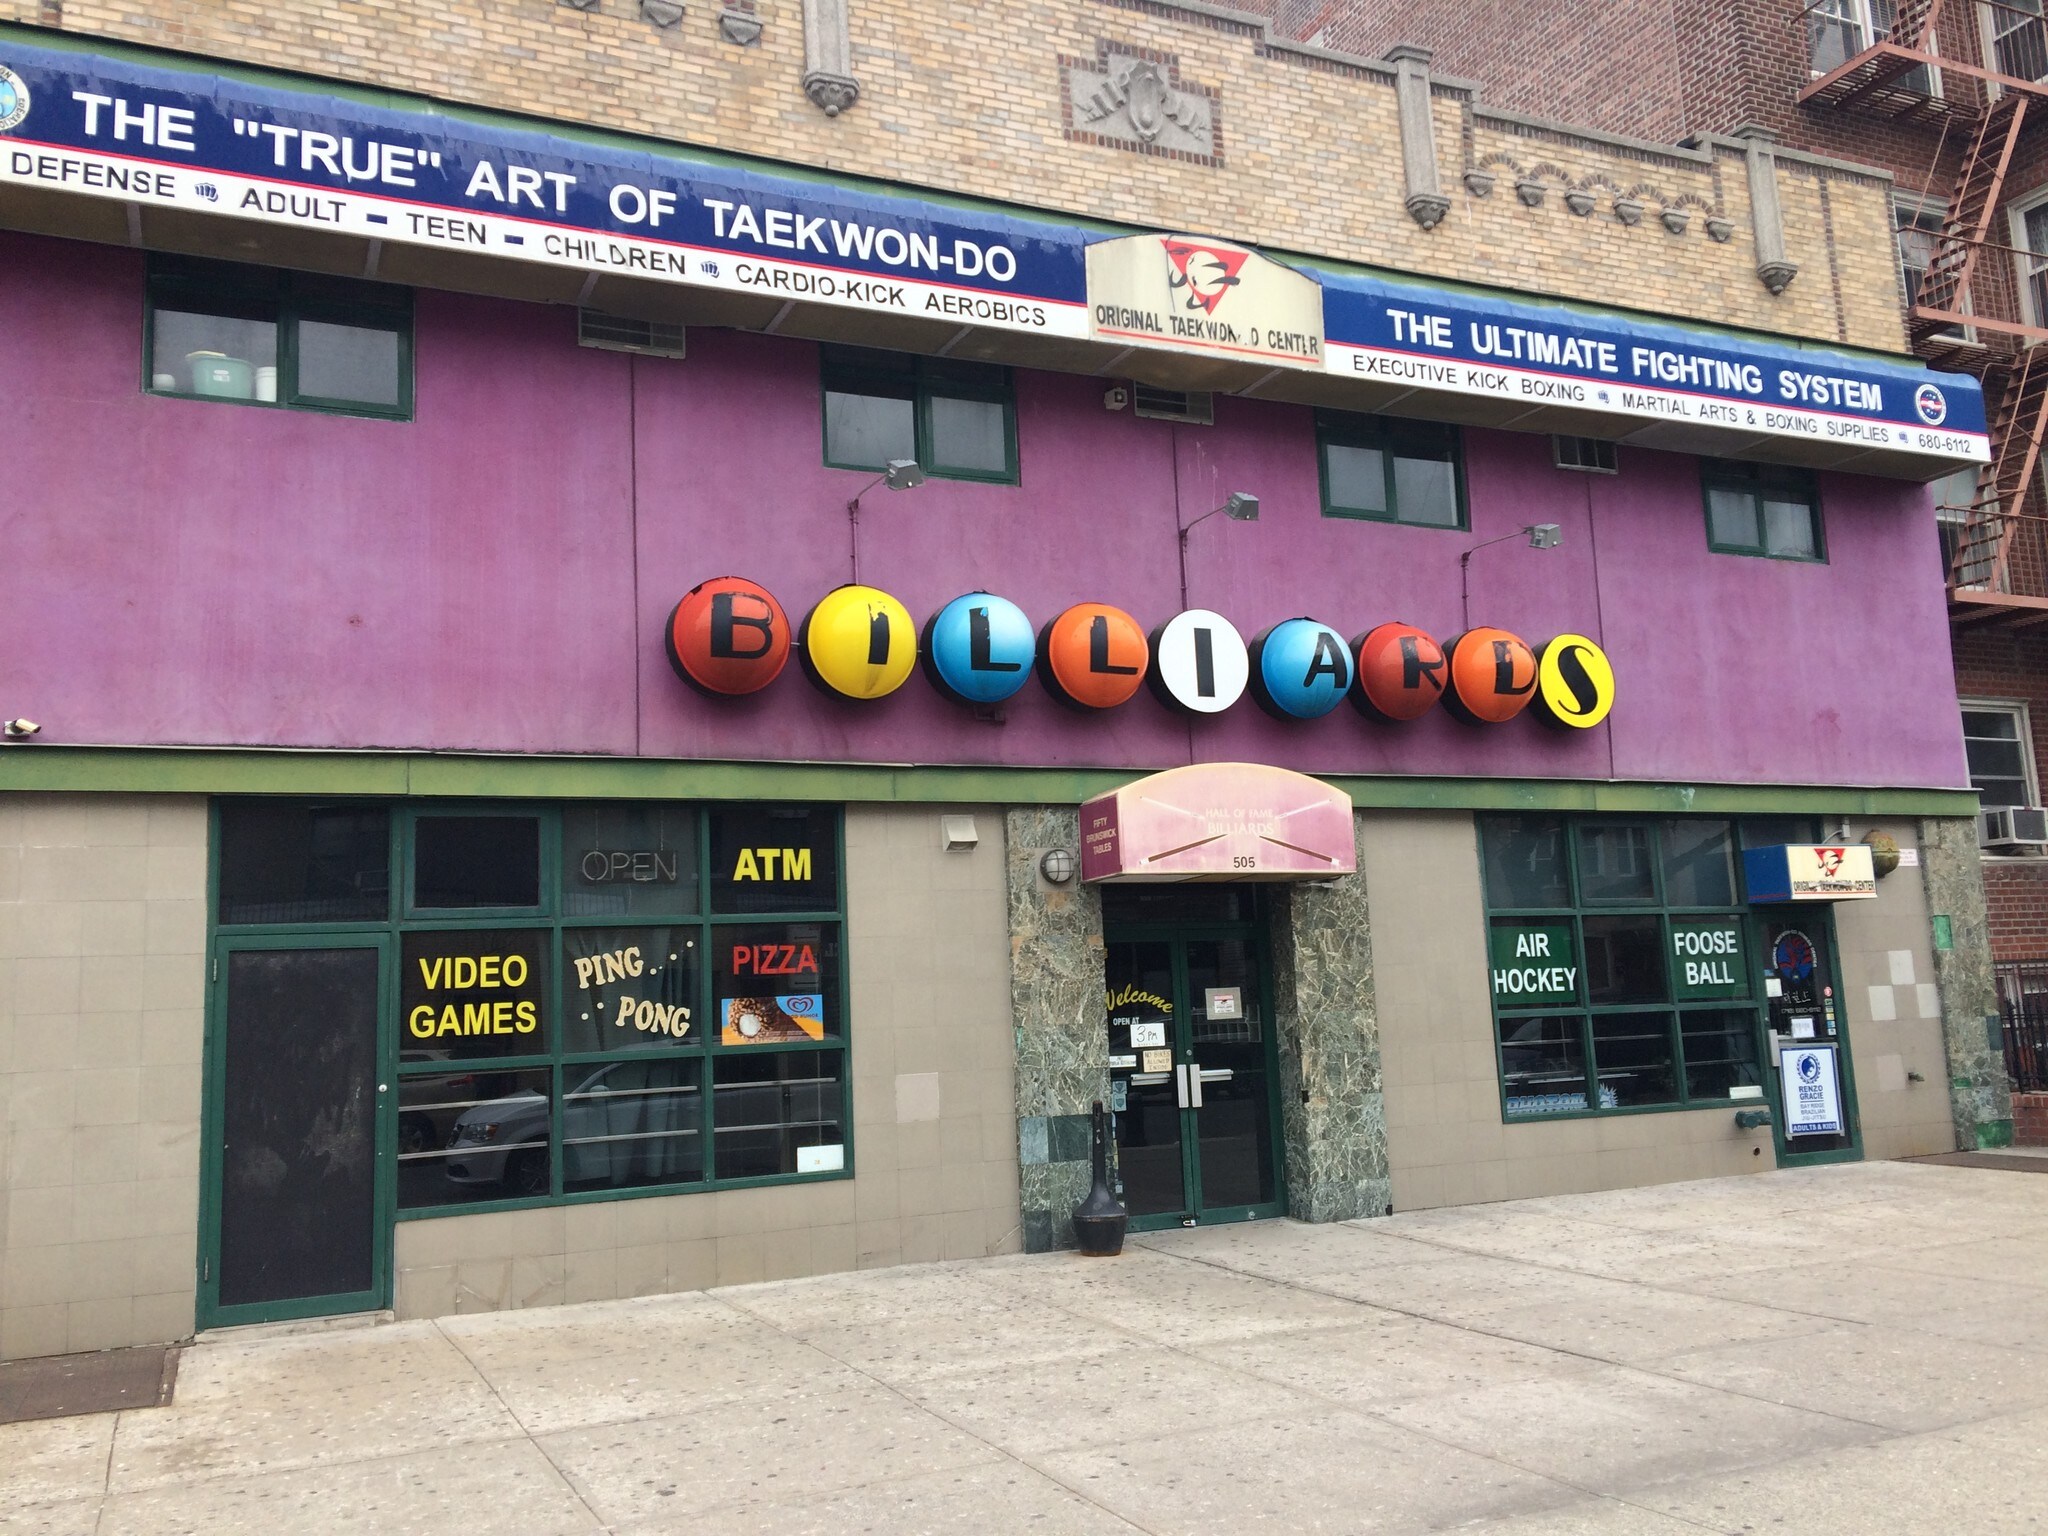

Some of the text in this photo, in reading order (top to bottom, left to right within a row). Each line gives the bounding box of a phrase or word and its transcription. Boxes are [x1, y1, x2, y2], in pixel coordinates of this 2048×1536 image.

[72, 91, 1017, 282] THE "TRUE" ART OF TAEKWON-DO
[11, 151, 1046, 327] DEFENSE ADULT TEEN CHILDREN CARDIO-KICK AEROBICS
[1096, 304, 1163, 333] ORIGINAL
[1386, 308, 1453, 350] THE
[1470, 322, 1619, 374] ULTIMATE
[1632, 347, 1764, 394] FIGHTING
[1778, 369, 1883, 412] SYSTEM
[1353, 354, 1971, 454] EXECUTIVE KICK BOXING MARTIAL ARTS & BOXING SUPPLIES 680-6112
[710, 592, 1595, 714] BILLIARDS
[1093, 816, 1108, 829] FIFTY
[1205, 807, 1230, 818] HALL
[1248, 808, 1273, 819] FAME
[1086, 828, 1117, 844] BRUNSWICK
[1208, 821, 1274, 837] BILLIARDS
[1093, 841, 1113, 856] TABLES
[1233, 856, 1256, 868] 505
[582, 851, 676, 881] OPEN
[733, 848, 812, 881] ATM
[1516, 933, 1551, 958] AIR
[1673, 931, 1738, 955] FOOSE
[419, 955, 528, 991] VIDEO
[574, 946, 644, 989] PING
[733, 944, 818, 976] PIZZA
[1685, 961, 1735, 985] BALL
[1494, 967, 1577, 994] HOCKEY
[409, 1001, 537, 1039] GAMES
[615, 995, 691, 1038] PONG
[1112, 1016, 1140, 1026] OPEN AT
[1136, 1025, 1158, 1043] 3 PM
[1800, 1092, 1824, 1100] GRACIE
[1793, 1124, 1816, 1132] ADULTS
